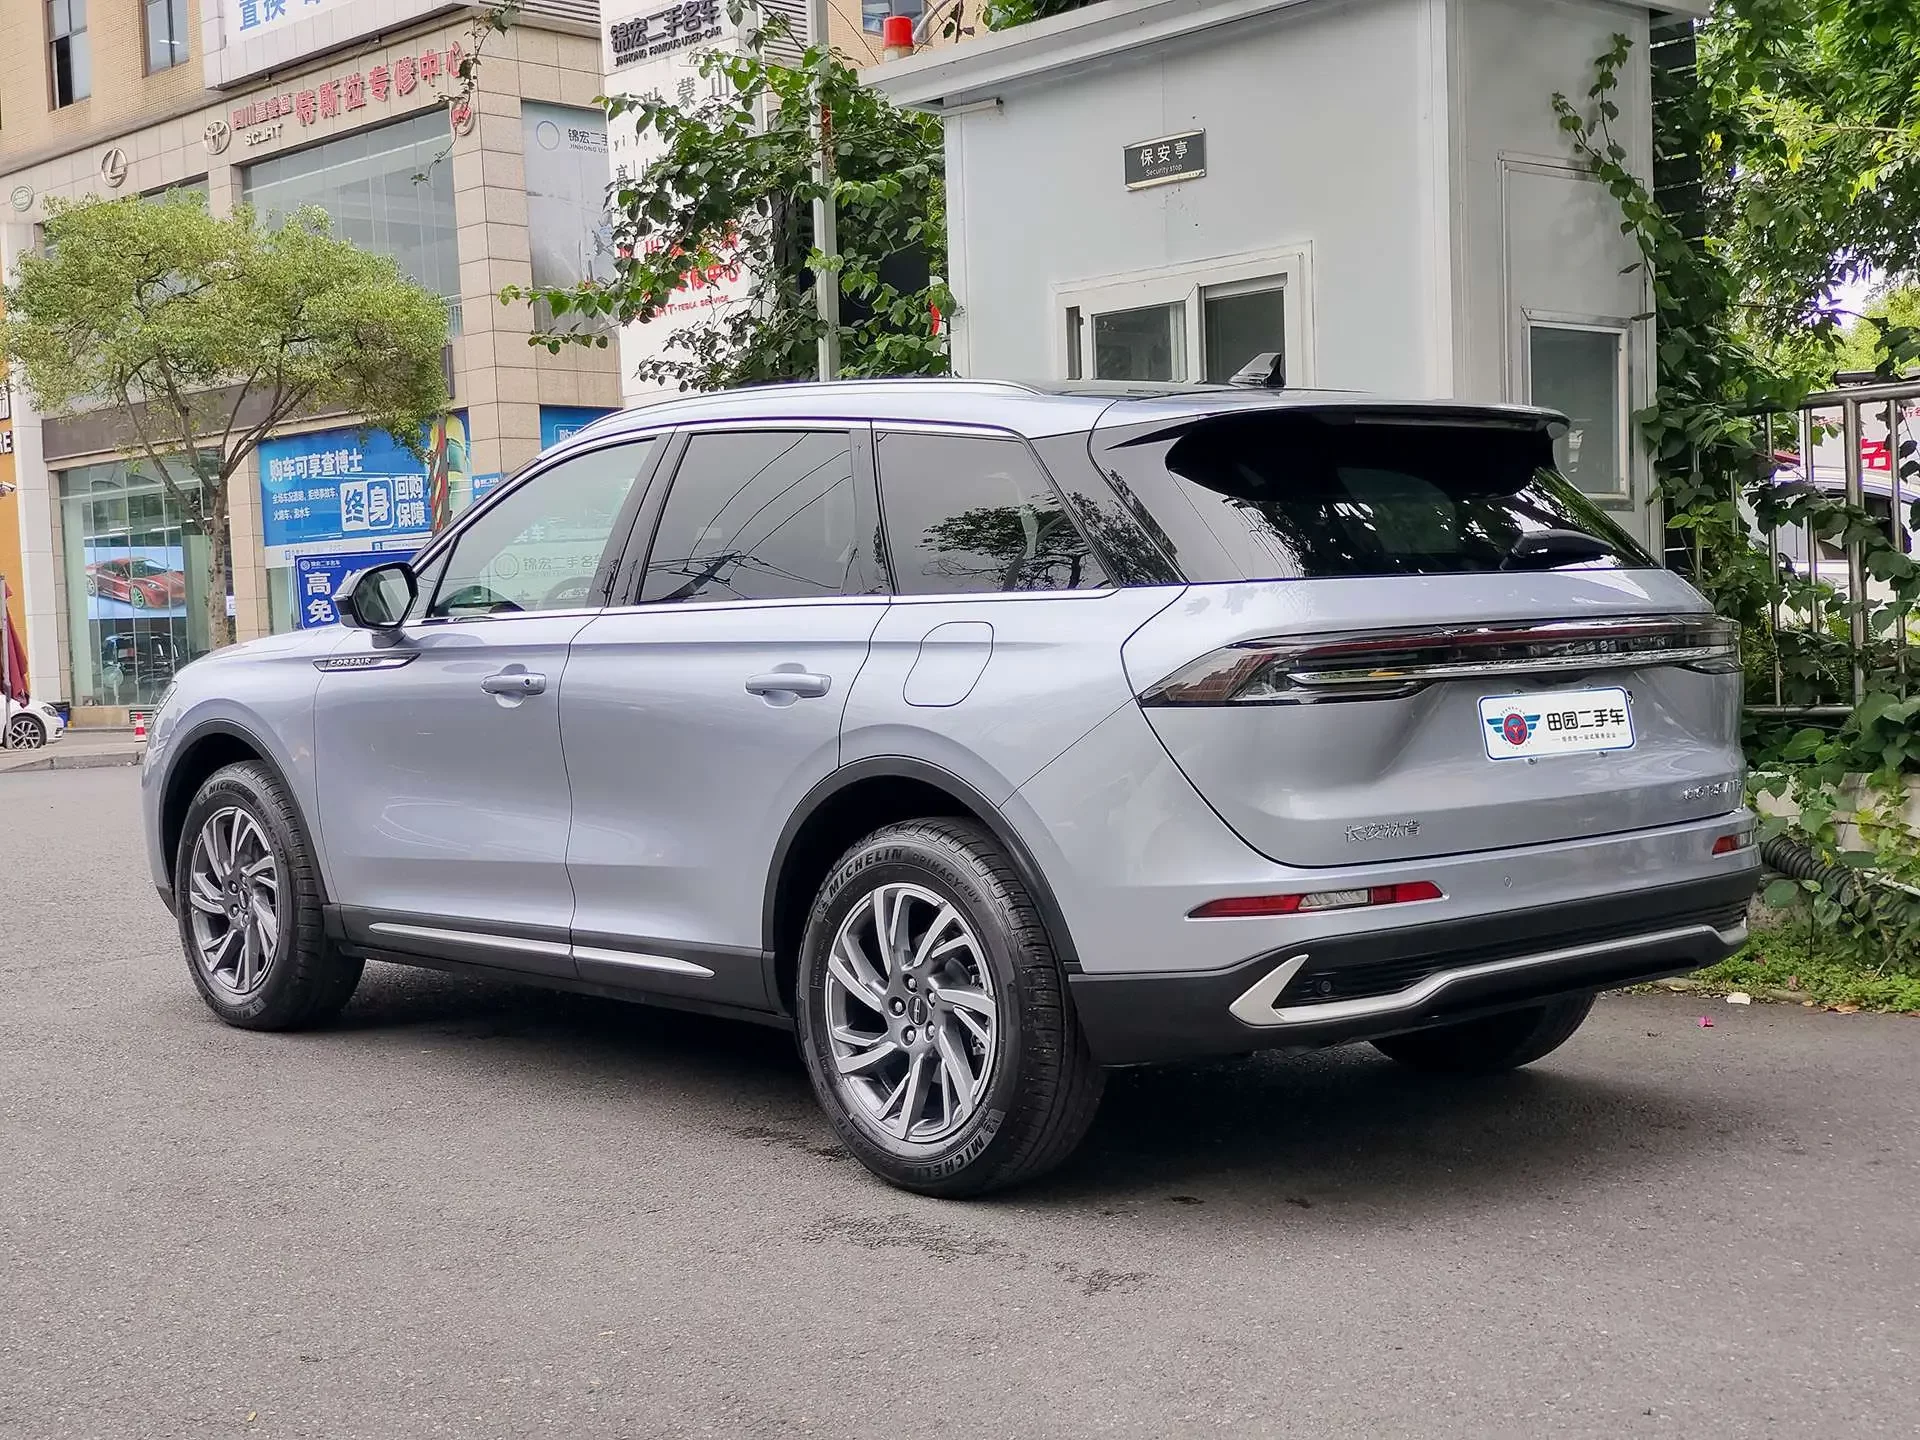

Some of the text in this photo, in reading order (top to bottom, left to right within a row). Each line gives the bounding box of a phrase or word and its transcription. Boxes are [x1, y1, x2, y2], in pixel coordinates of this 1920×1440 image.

[610, 0, 721, 54] 锦宏二手名车
[1140, 140, 1188, 168] 保安亭
[1145, 167, 1169, 177] Security
[269, 448, 363, 483] 购车可享查博士
[395, 475, 424, 501] 回购
[344, 485, 391, 524] 终身
[396, 501, 426, 528] 保障
[307, 599, 335, 624] 免
[330, 657, 372, 668] CORSAIR
[1546, 708, 1626, 731] 田园二手车
[828, 846, 905, 896] MICHELIN
